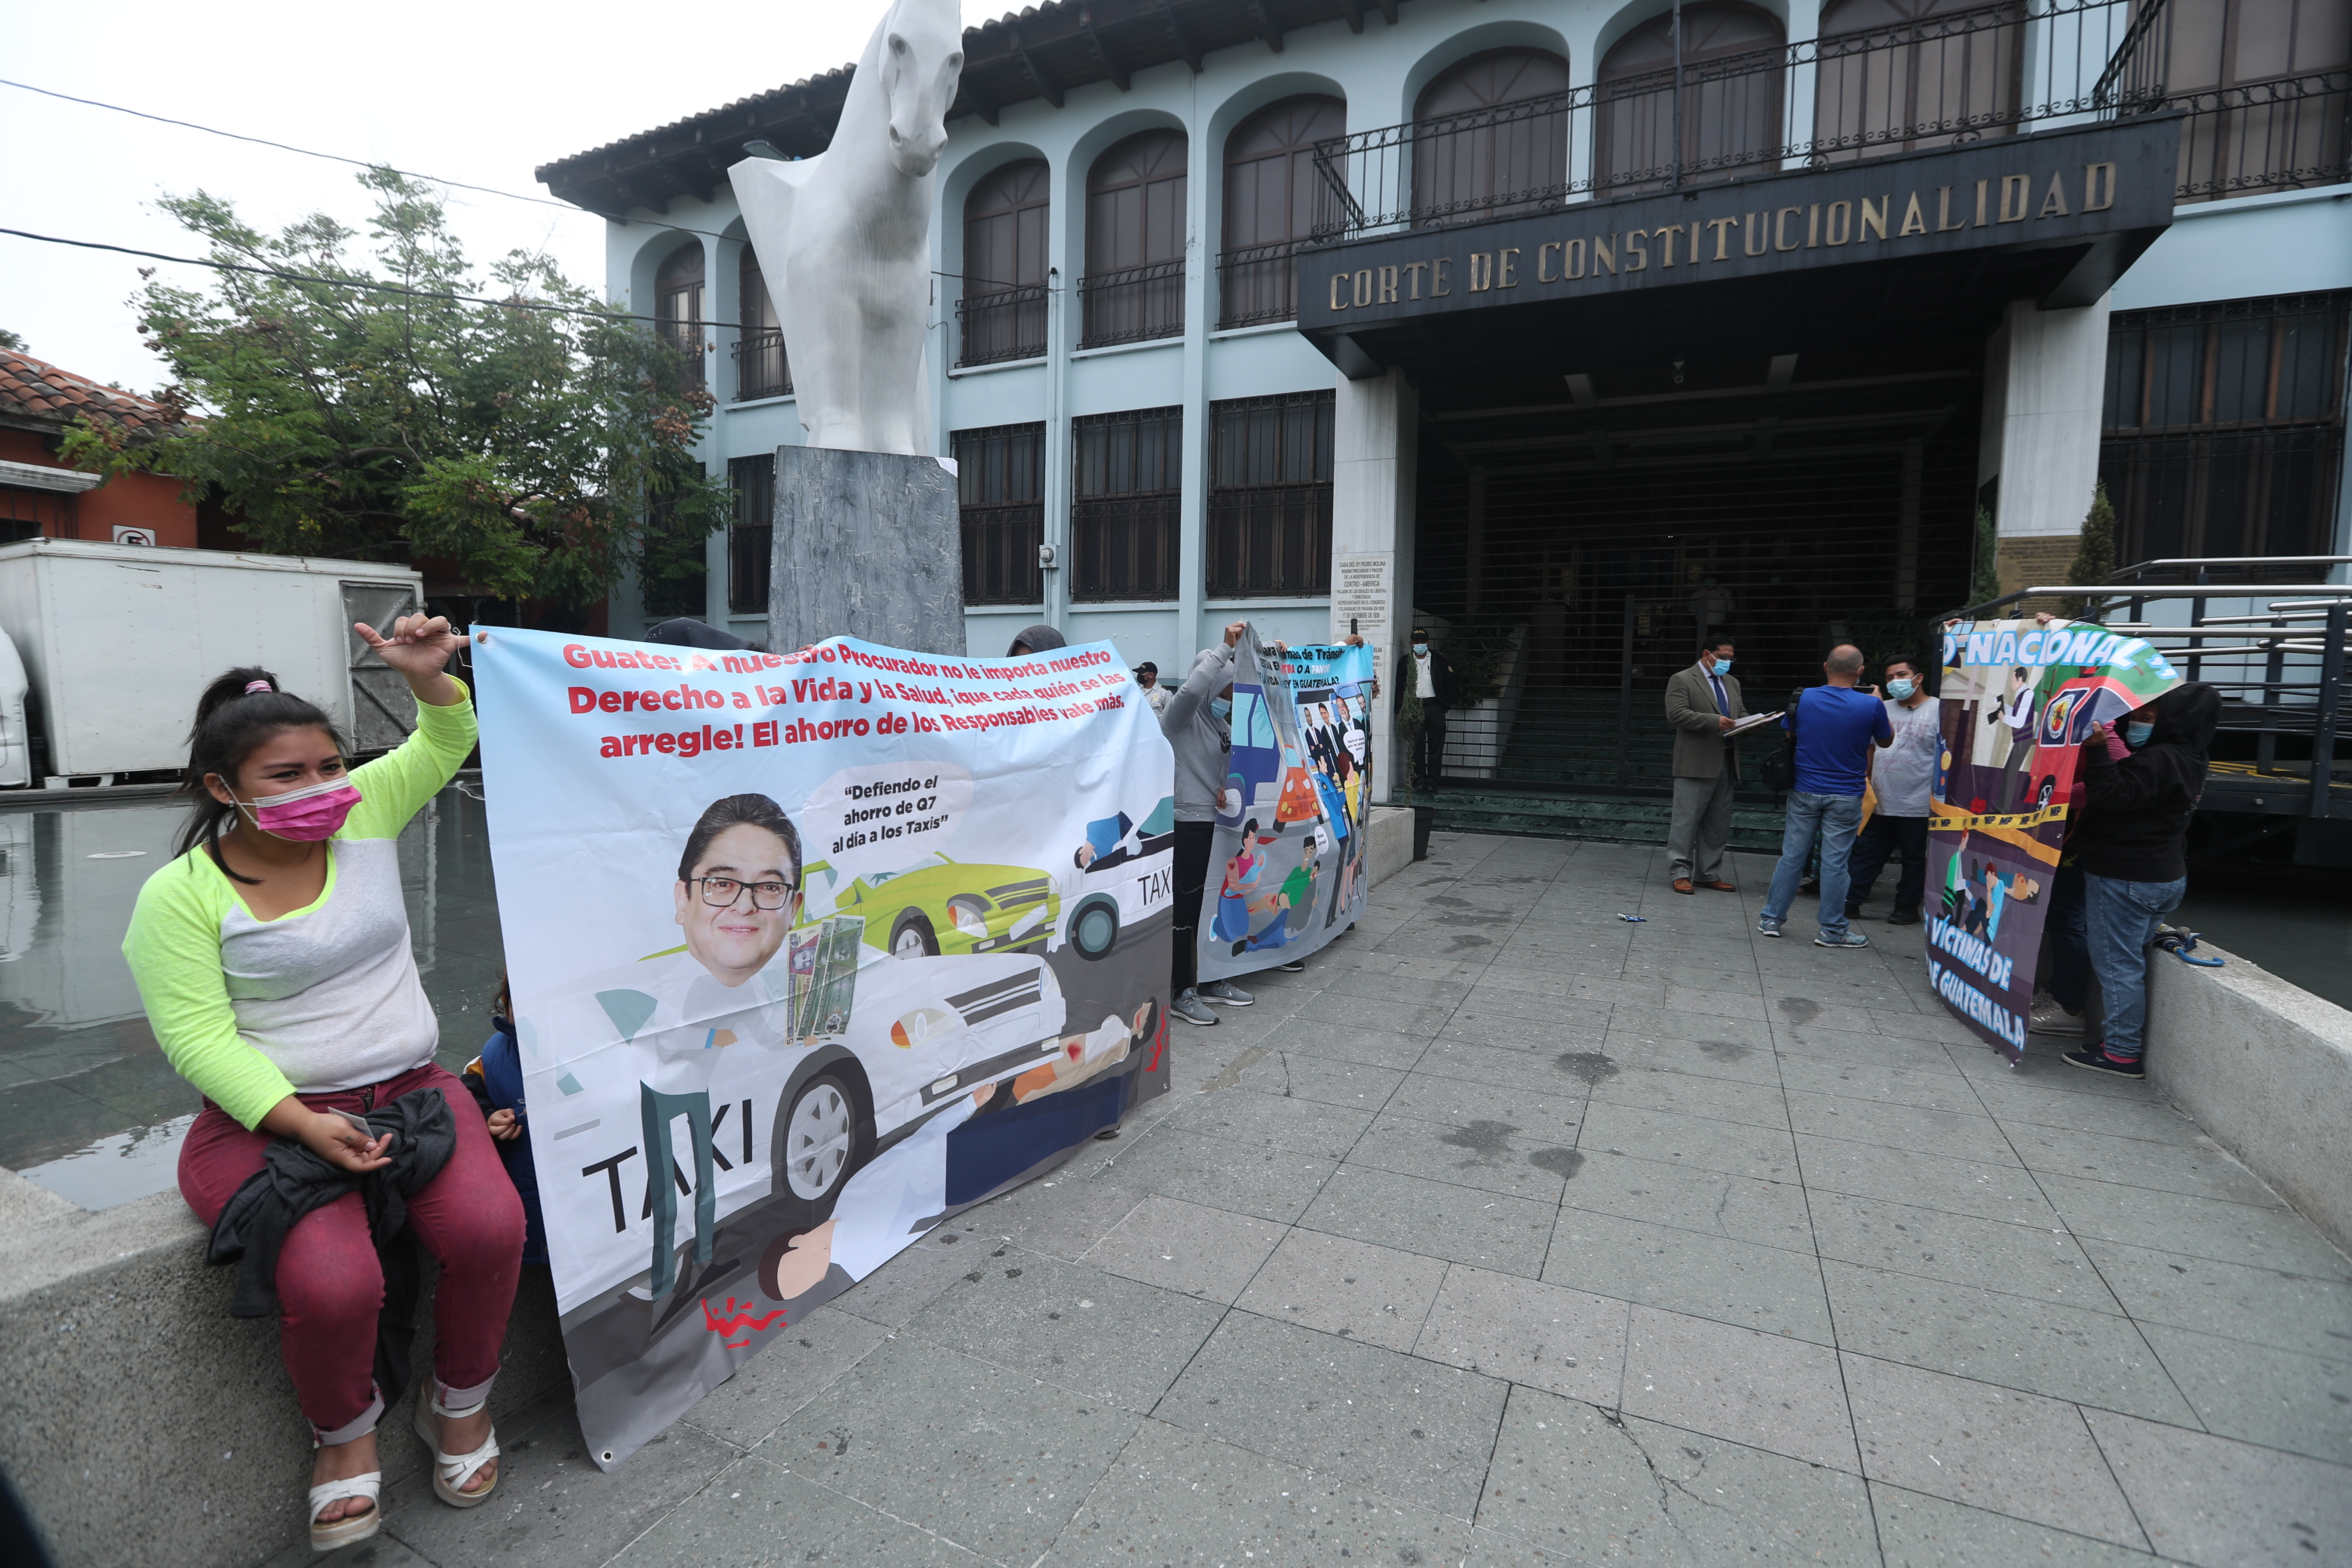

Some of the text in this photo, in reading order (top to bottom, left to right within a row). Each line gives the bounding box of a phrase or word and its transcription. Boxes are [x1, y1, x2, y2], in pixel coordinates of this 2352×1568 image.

[1329, 161, 2116, 313] CORTE DE CONSTITUCIONALIDAD
[563, 643, 1112, 682] Guate: A nuestro Procurador no le importa nuestro
[1297, 665, 1303, 674] O
[1305, 665, 1310, 674] A
[1302, 649, 1313, 660] de
[568, 684, 725, 715] Derecho
[732, 692, 752, 710] a
[758, 684, 787, 706] la
[791, 677, 857, 704] Vida
[858, 680, 873, 704] y
[873, 678, 895, 701] la
[895, 682, 955, 708] Salud,
[993, 686, 1032, 702] cada
[1033, 680, 1079, 702] quién
[1079, 678, 1099, 691] se
[1097, 672, 1126, 688] las
[600, 692, 1125, 758] arregle! El ahorro de los Responsables vale más.
[925, 774, 938, 789] el
[844, 796, 937, 827] ahorro de Q7
[2050, 806, 2061, 817] MP
[832, 838, 844, 854] al
[845, 830, 866, 850] día
[869, 830, 878, 844] a
[881, 824, 902, 840] los
[1931, 914, 1993, 976] VÍCTIMAS
[1988, 951, 2013, 992] DE
[1939, 969, 2026, 1052] GUATEMALA
